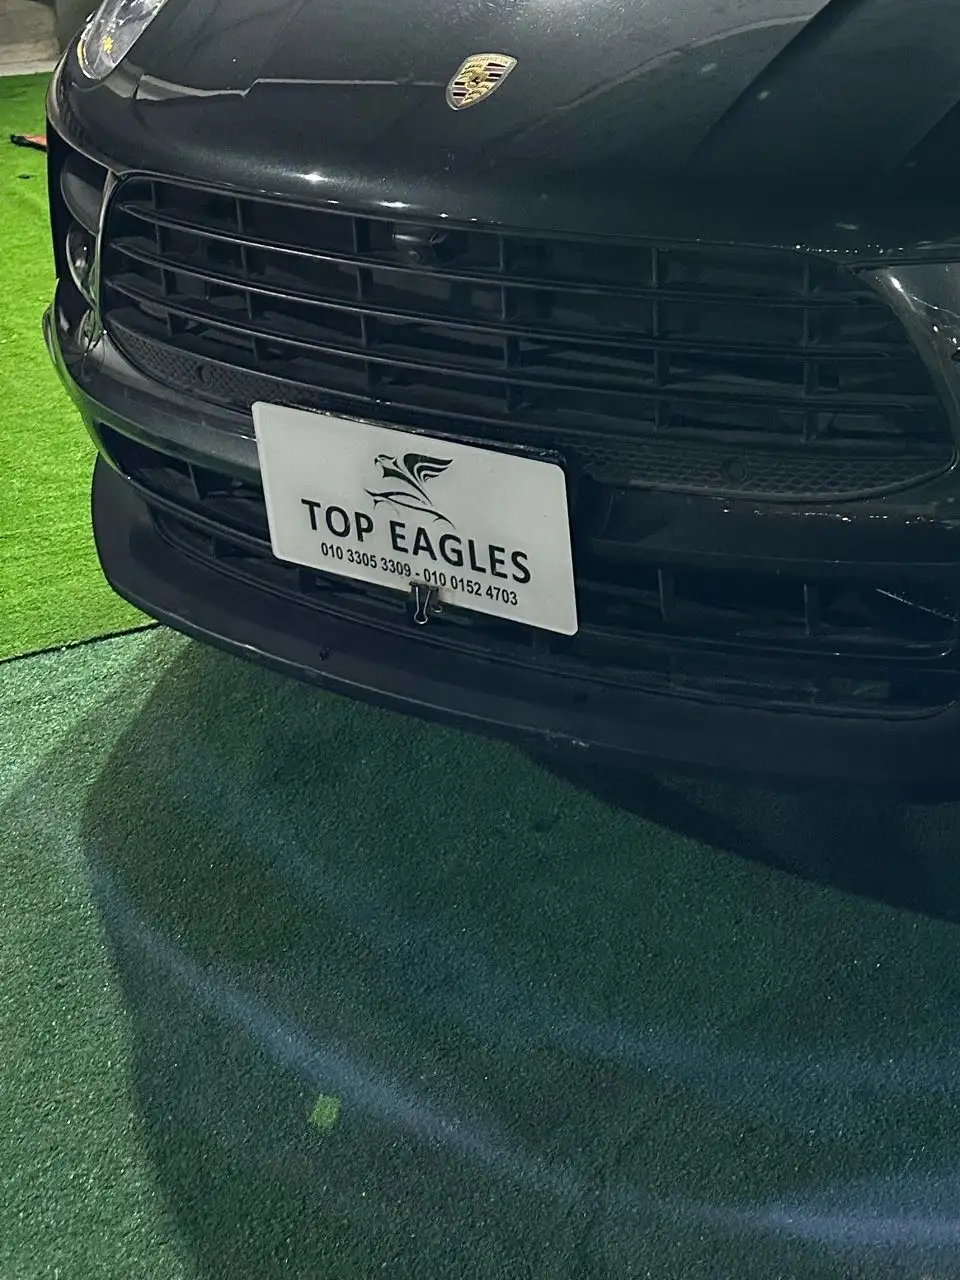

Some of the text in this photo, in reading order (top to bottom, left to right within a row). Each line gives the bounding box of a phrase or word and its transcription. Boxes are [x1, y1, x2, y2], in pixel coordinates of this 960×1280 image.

[301, 498, 532, 584] TOP EAGLES
[320, 542, 344, 561] 010
[346, 548, 378, 569] 3305
[380, 557, 412, 578] 3309
[423, 568, 447, 588] 010
[450, 575, 482, 597] 0152
[485, 584, 518, 606] 4703
